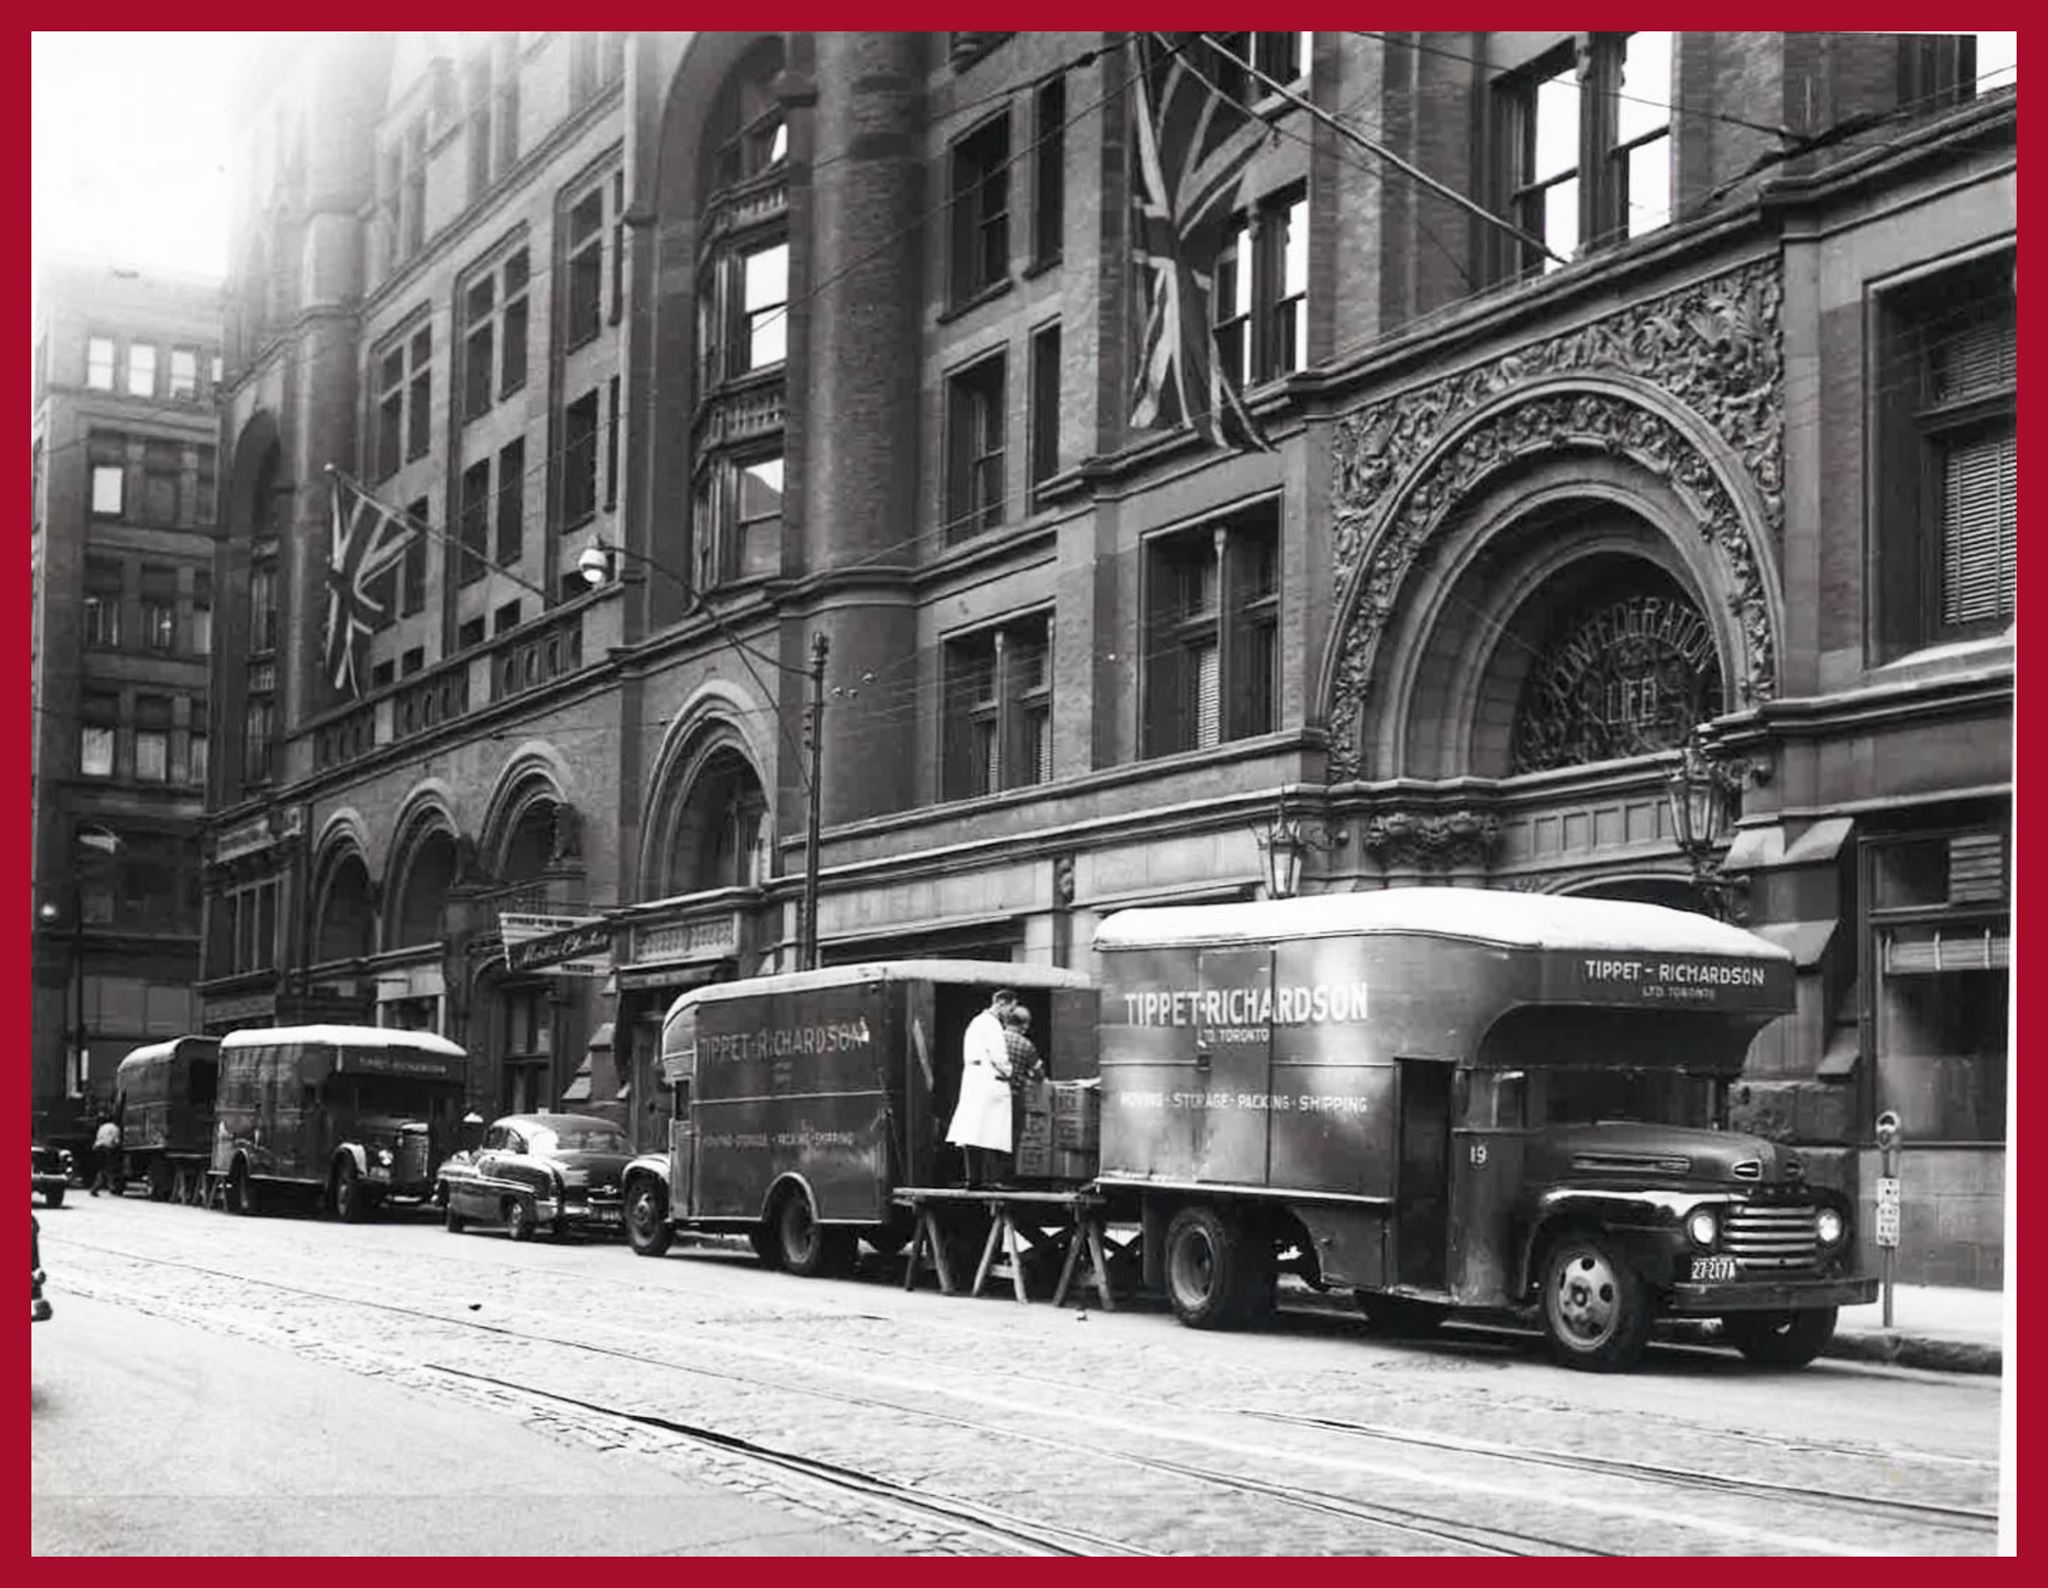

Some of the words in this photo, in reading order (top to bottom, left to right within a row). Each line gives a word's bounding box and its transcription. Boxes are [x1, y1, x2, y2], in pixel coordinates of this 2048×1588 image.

[1606, 676, 1657, 724] LIFE
[1584, 959, 1642, 980] TIPPET
[1659, 963, 1765, 986] RICHARDSON
[1219, 1028, 1270, 1043] TORONTO
[1299, 1094, 1368, 1113] SHIPPING
[1470, 1145, 1487, 1164] 19
